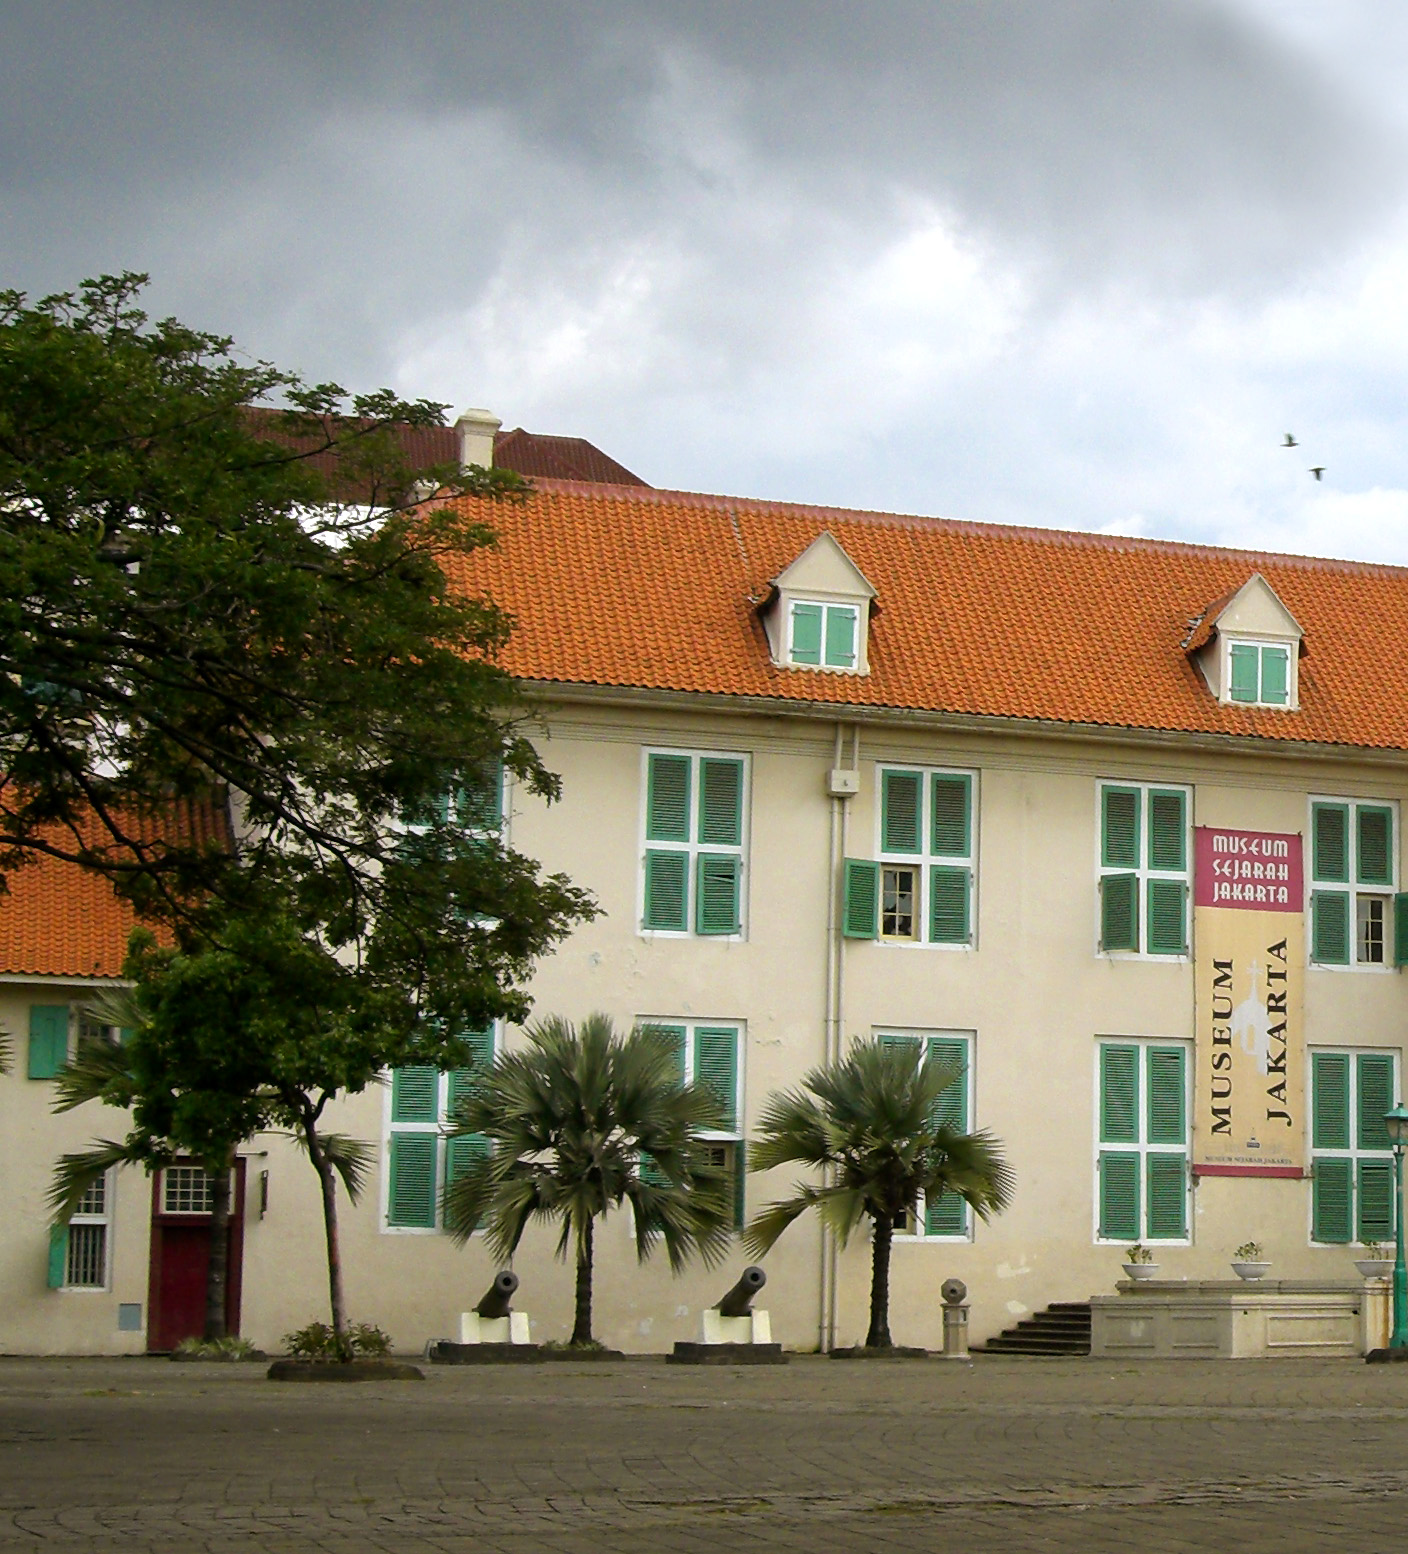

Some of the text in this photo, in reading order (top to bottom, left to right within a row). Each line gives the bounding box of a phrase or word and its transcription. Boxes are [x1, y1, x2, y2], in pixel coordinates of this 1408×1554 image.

[1213, 835, 1288, 858] MUSEUM
[1212, 859, 1289, 881] SEJARAH
[1213, 882, 1288, 904] JAKARTA
[1266, 937, 1292, 1127] JAKARTA
[1211, 958, 1233, 1136] MUSEUM
